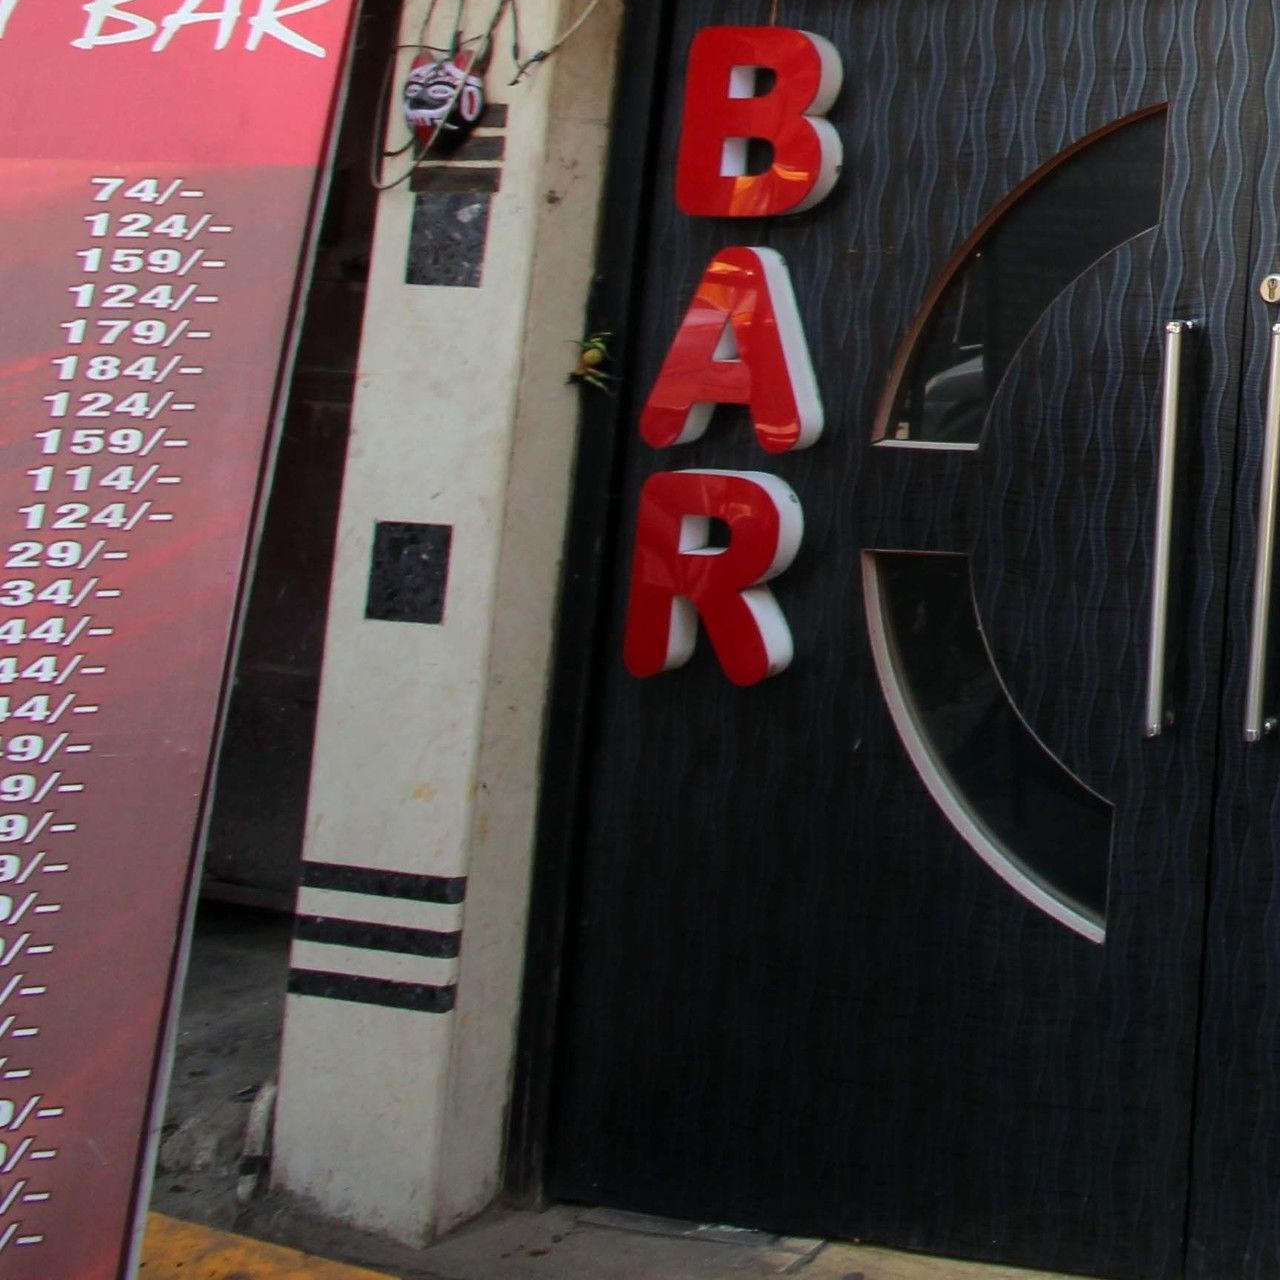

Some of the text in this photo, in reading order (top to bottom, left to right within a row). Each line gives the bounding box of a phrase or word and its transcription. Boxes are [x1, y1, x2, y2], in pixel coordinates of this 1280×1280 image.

[90, 178, 204, 204] 74/-
[83, 213, 232, 241] 124/-
[76, 248, 226, 276] 159/-
[68, 284, 219, 311] 124/-
[60, 319, 211, 348] 179/-
[51, 355, 204, 383] 184/-
[622, 23, 845, 687] BAR
[43, 390, 196, 419] 124/-
[35, 427, 189, 457] 159/-
[26, 464, 182, 494] 114/-
[18, 502, 173, 531] 124/-
[4, 540, 128, 569] 29/-
[0, 693, 99, 723] 4/-
